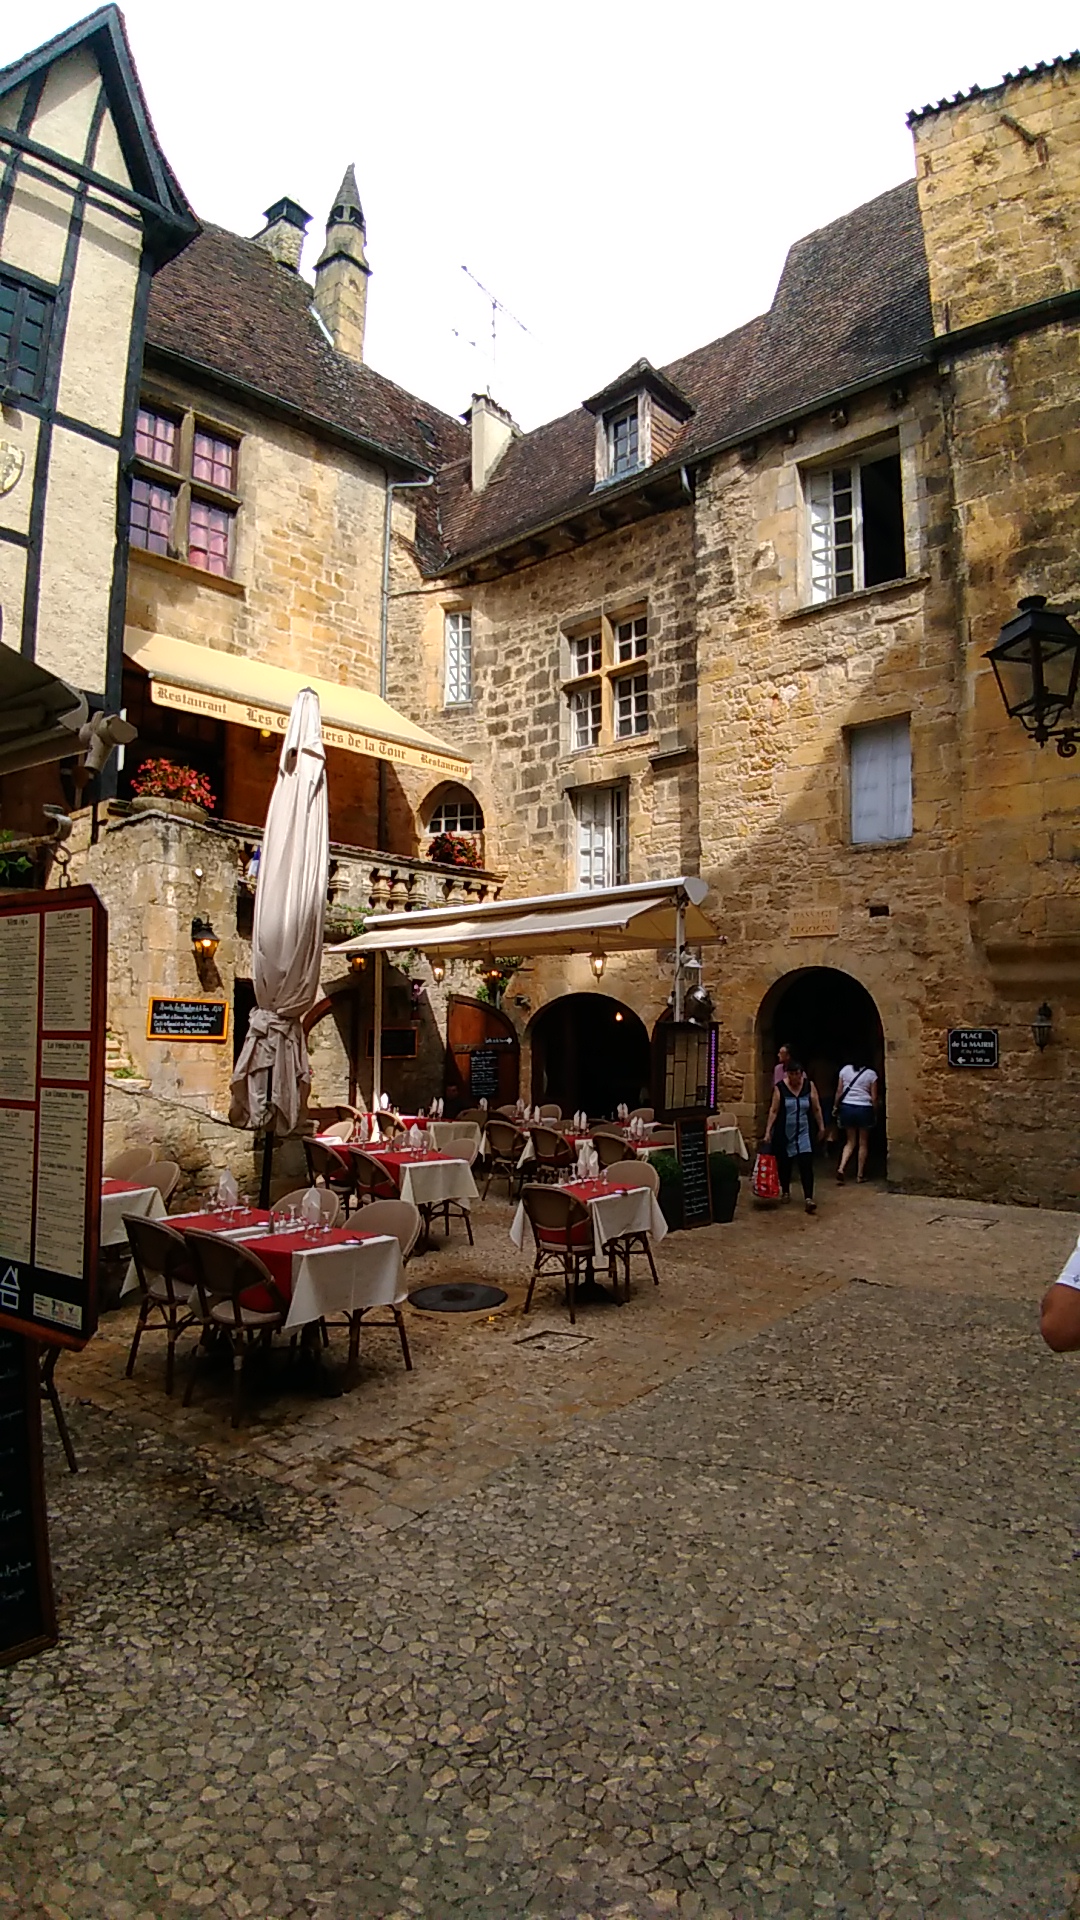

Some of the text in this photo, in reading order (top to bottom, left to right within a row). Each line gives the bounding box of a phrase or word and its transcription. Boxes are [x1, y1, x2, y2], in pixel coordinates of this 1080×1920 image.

[157, 686, 227, 714] Restaurant
[246, 707, 272, 726] Les
[348, 733, 361, 748] de
[364, 738, 375, 752] la
[378, 741, 407, 760] Tour
[420, 753, 469, 775] Restaurant
